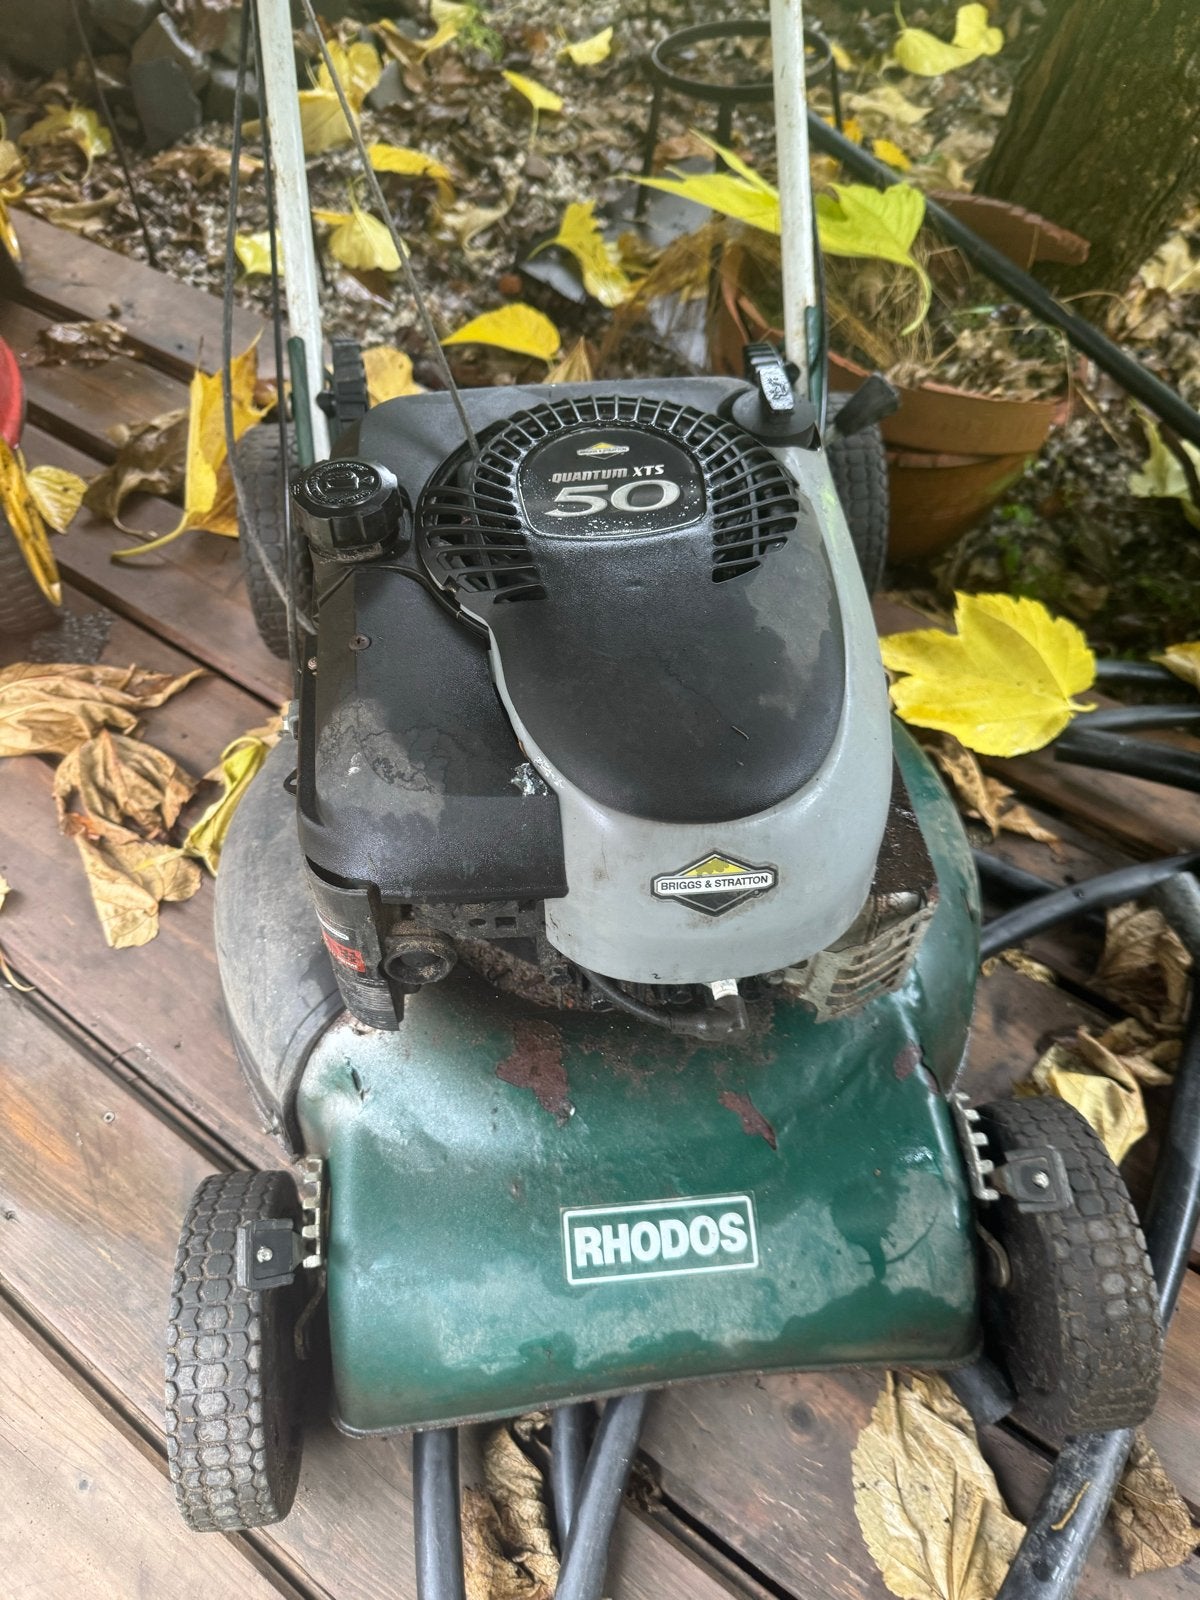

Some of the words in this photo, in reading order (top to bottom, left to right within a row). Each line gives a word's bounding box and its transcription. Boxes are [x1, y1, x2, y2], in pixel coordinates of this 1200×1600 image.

[551, 467, 628, 484] QUANTUM
[632, 464, 665, 477] XTS
[544, 479, 681, 518] 50
[660, 880, 702, 891] BRIGGS
[704, 879, 713, 889] &
[714, 875, 769, 887] STRATTON
[573, 1212, 748, 1268] RHODOS
